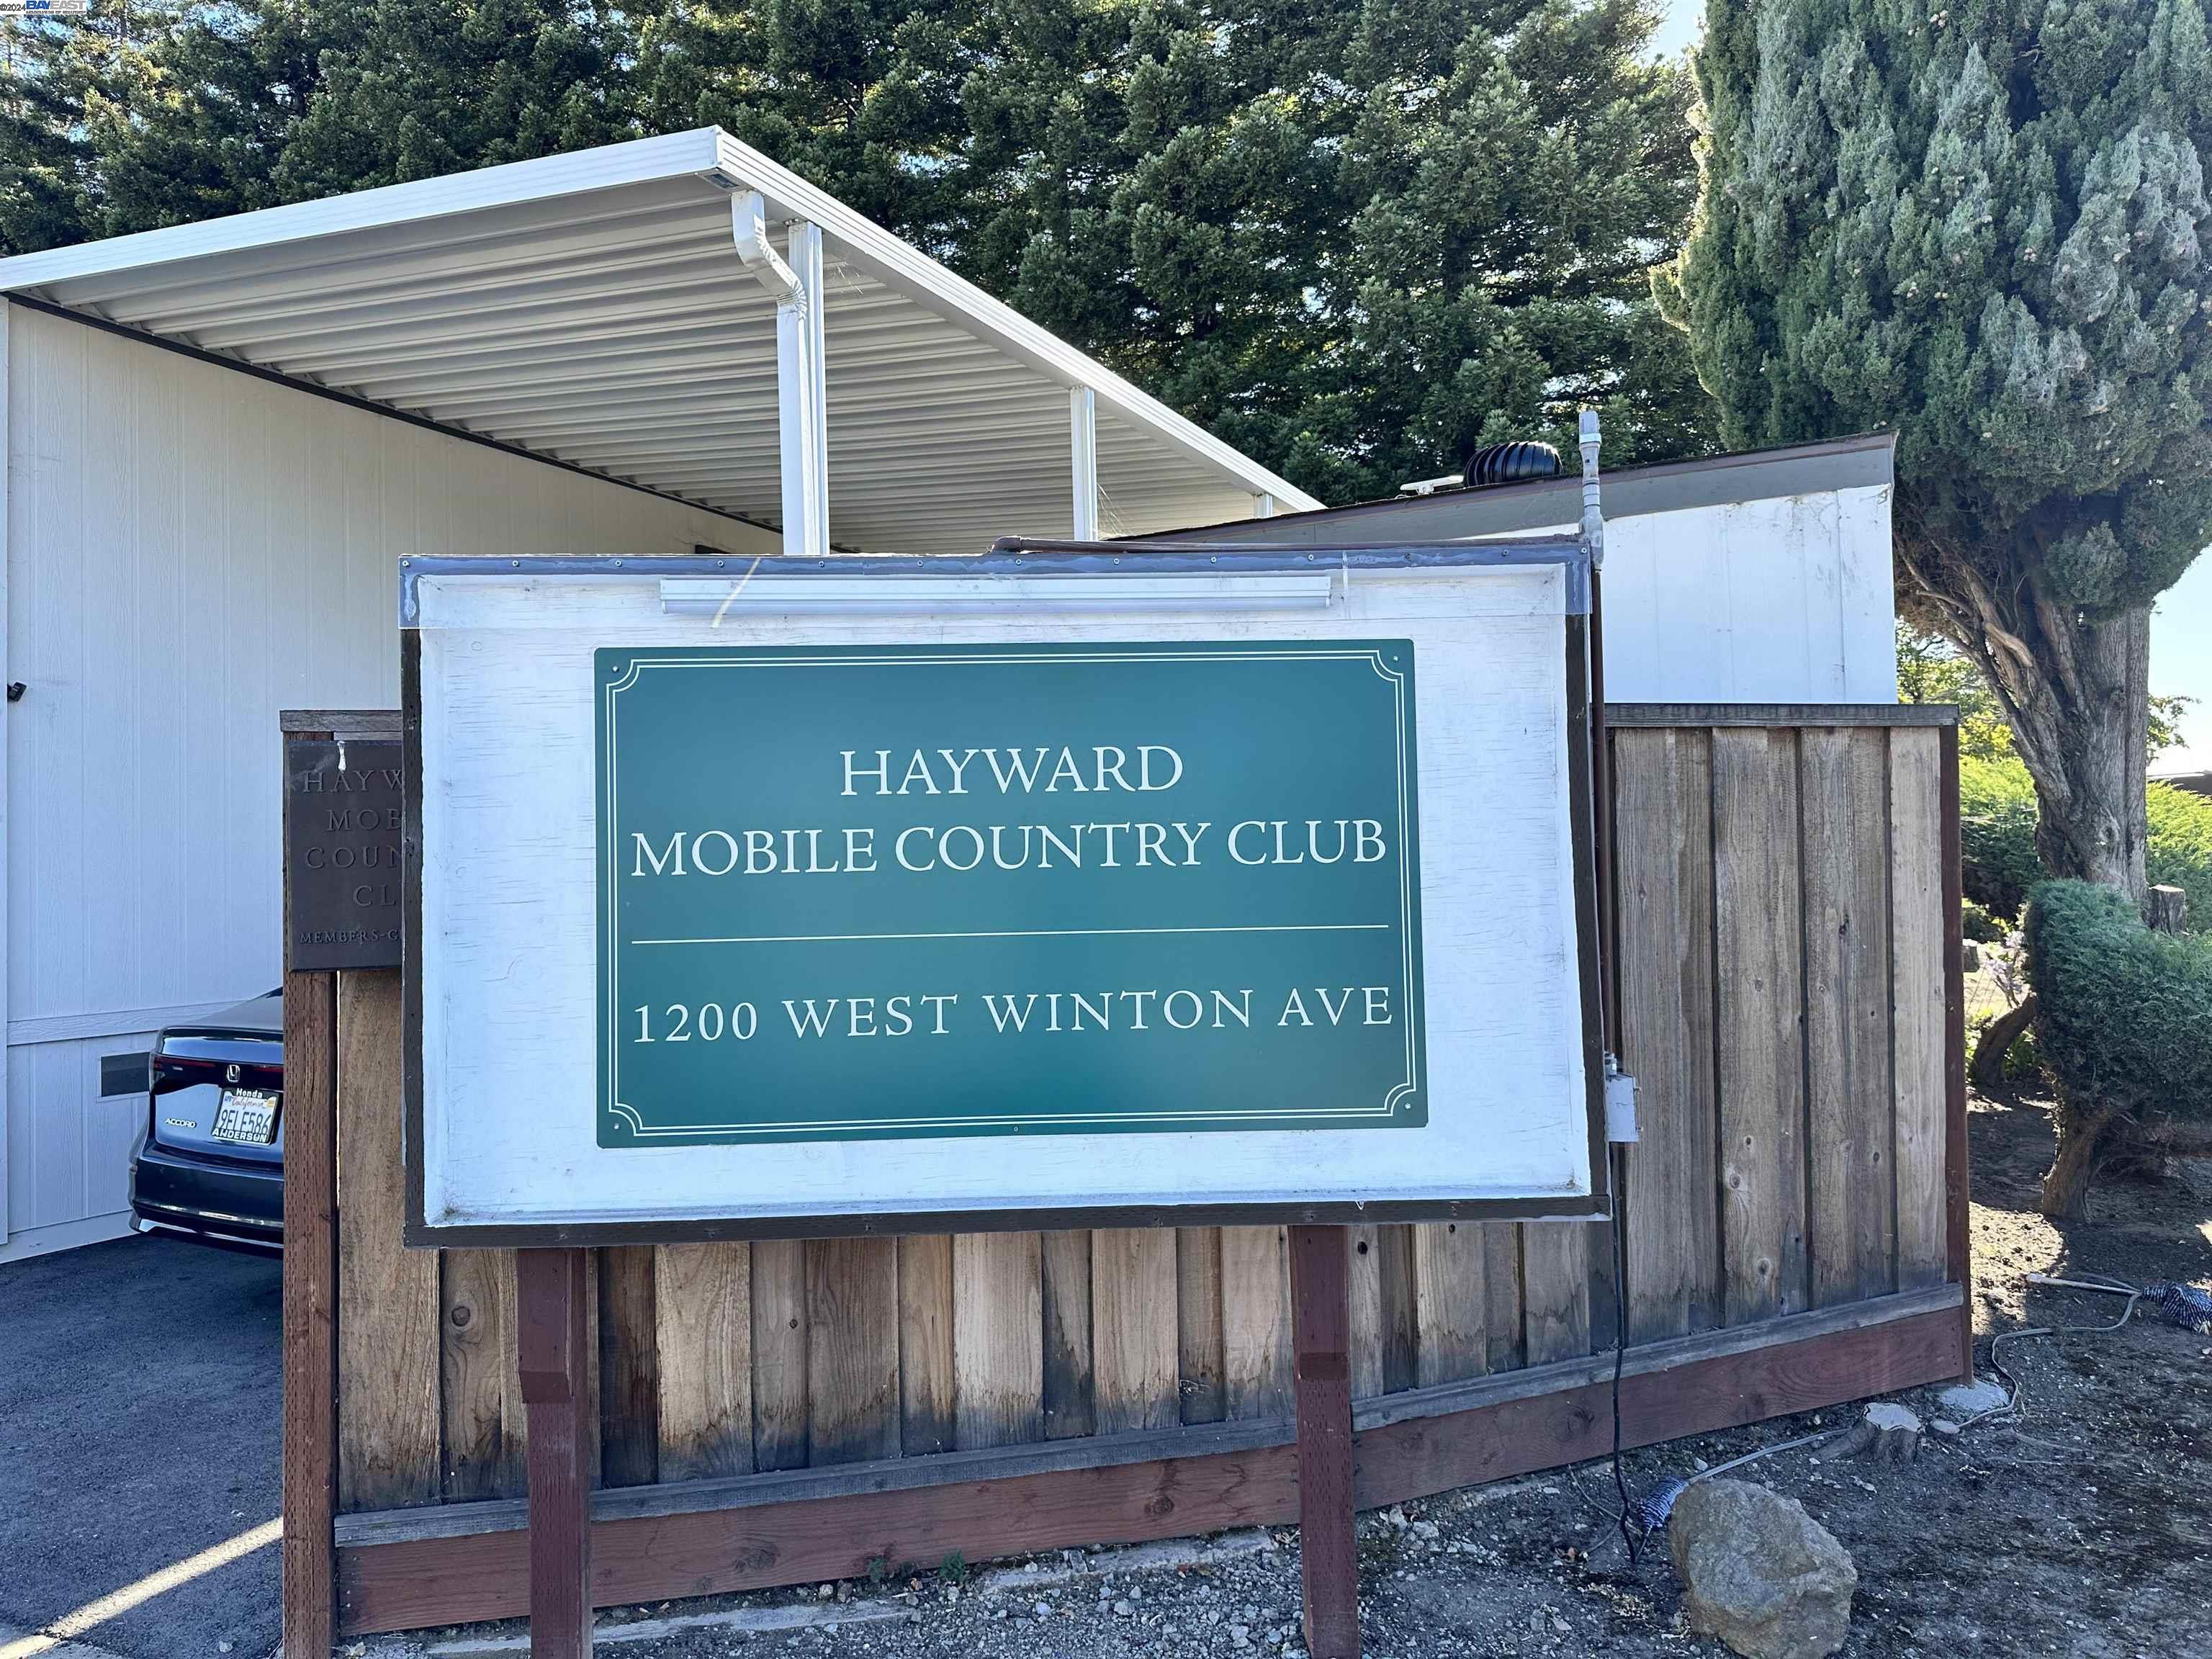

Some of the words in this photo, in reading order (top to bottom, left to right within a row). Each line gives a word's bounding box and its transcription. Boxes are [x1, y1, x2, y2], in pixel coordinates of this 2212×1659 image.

[840, 746, 1183, 796] HAYWARD
[631, 827, 877, 876] MOBILE
[896, 821, 1211, 871] COUNTRY
[1228, 819, 1386, 865] CLUB
[634, 1002, 757, 1043] 1200
[782, 994, 958, 1038] WEST
[982, 989, 1254, 1033] WINTON
[1278, 987, 1393, 1026] AVE
[236, 1088, 263, 1098] Honda
[165, 1118, 197, 1128] ACCORD
[212, 1128, 267, 1143] ANDERSON
